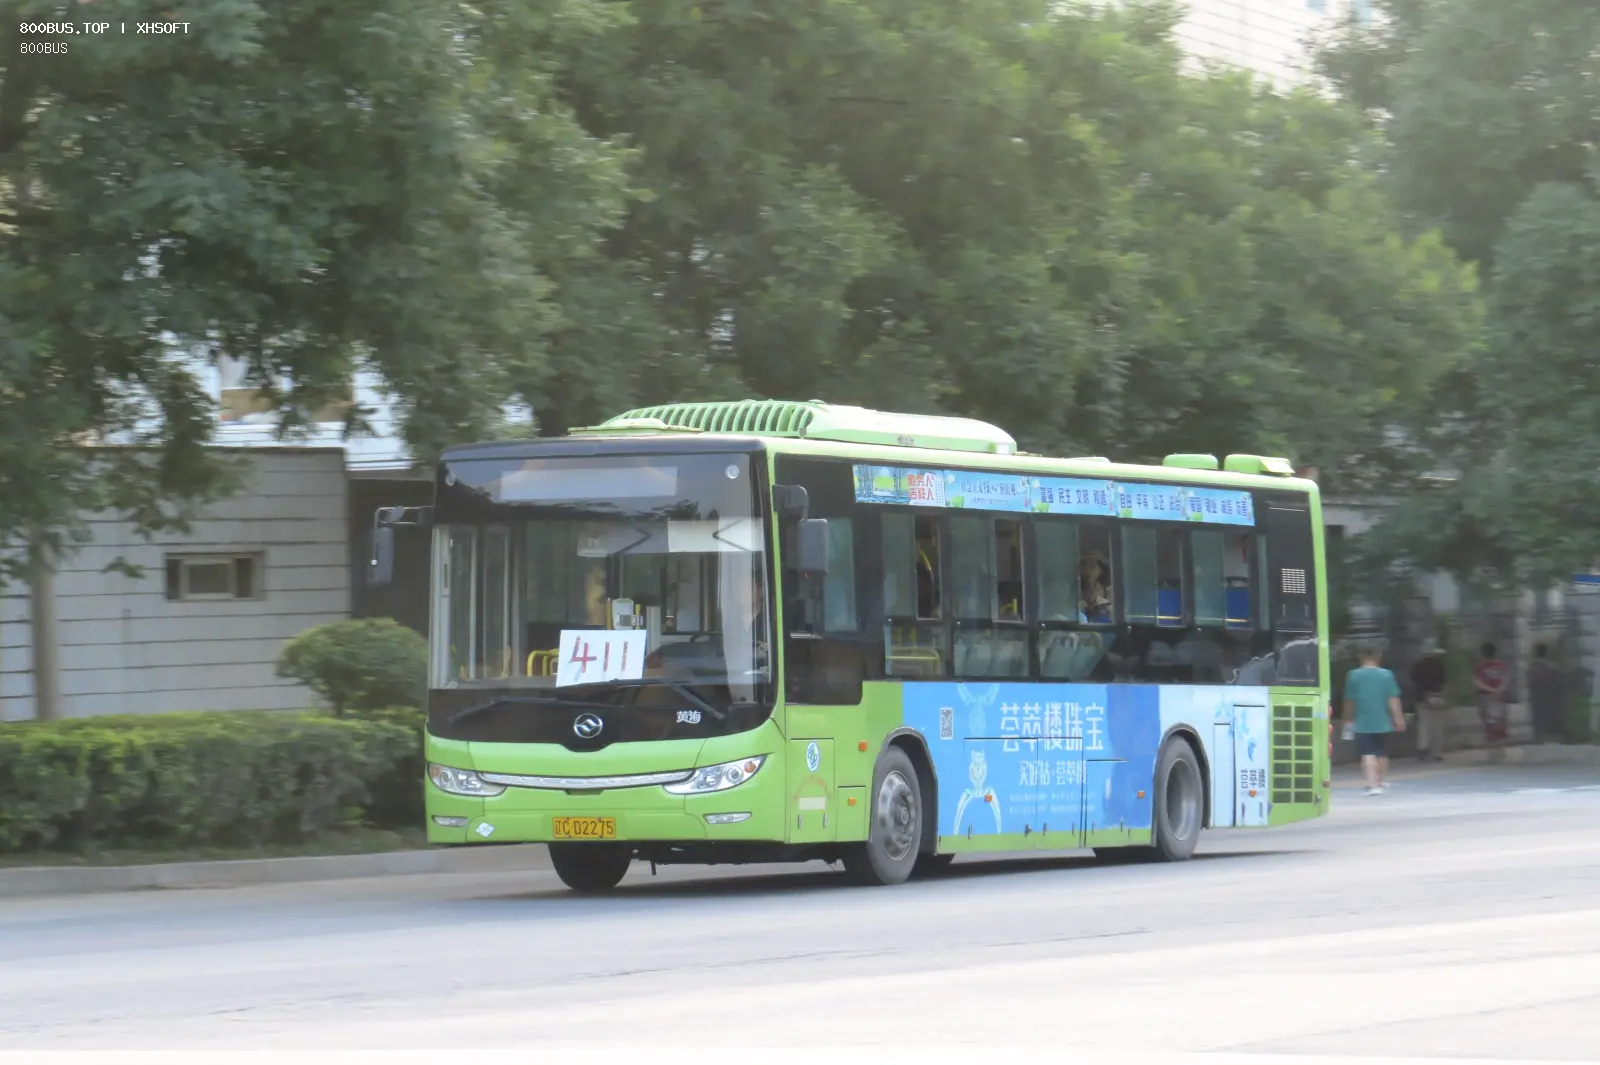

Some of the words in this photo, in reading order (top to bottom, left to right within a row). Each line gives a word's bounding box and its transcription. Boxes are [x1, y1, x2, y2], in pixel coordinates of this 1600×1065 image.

[568, 635, 629, 674] 411
[1000, 702, 1104, 752] 荟萃楼珠宝
